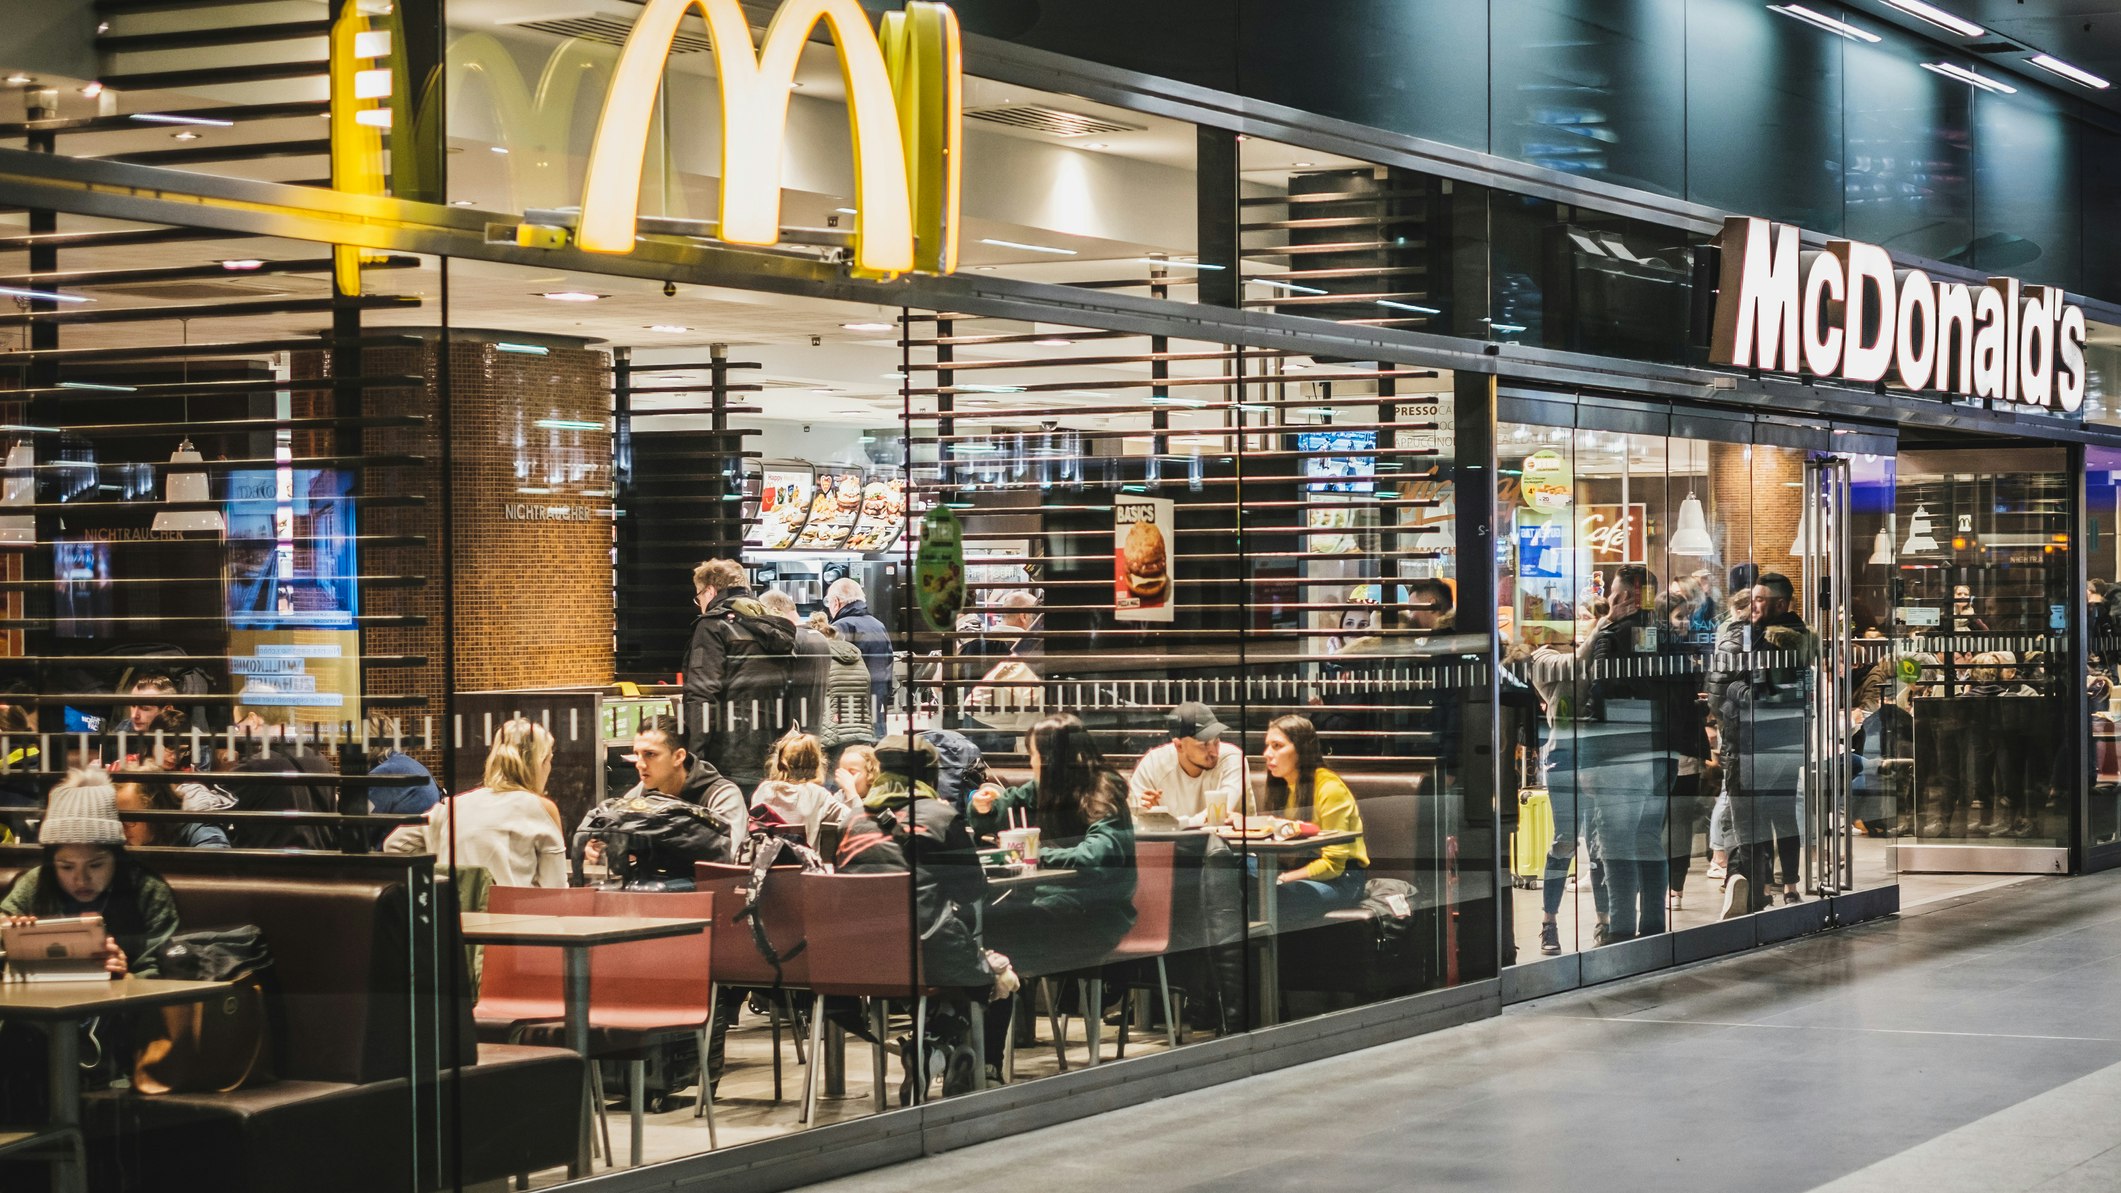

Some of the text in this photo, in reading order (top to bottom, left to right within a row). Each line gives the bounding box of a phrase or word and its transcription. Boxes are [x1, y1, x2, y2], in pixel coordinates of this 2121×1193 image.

[1731, 216, 2087, 412] McDonald's
[505, 504, 590, 520] NICHTRAUCHER
[1117, 505, 1155, 523] BASICS
[85, 528, 184, 541] NICHTRAUCHER
